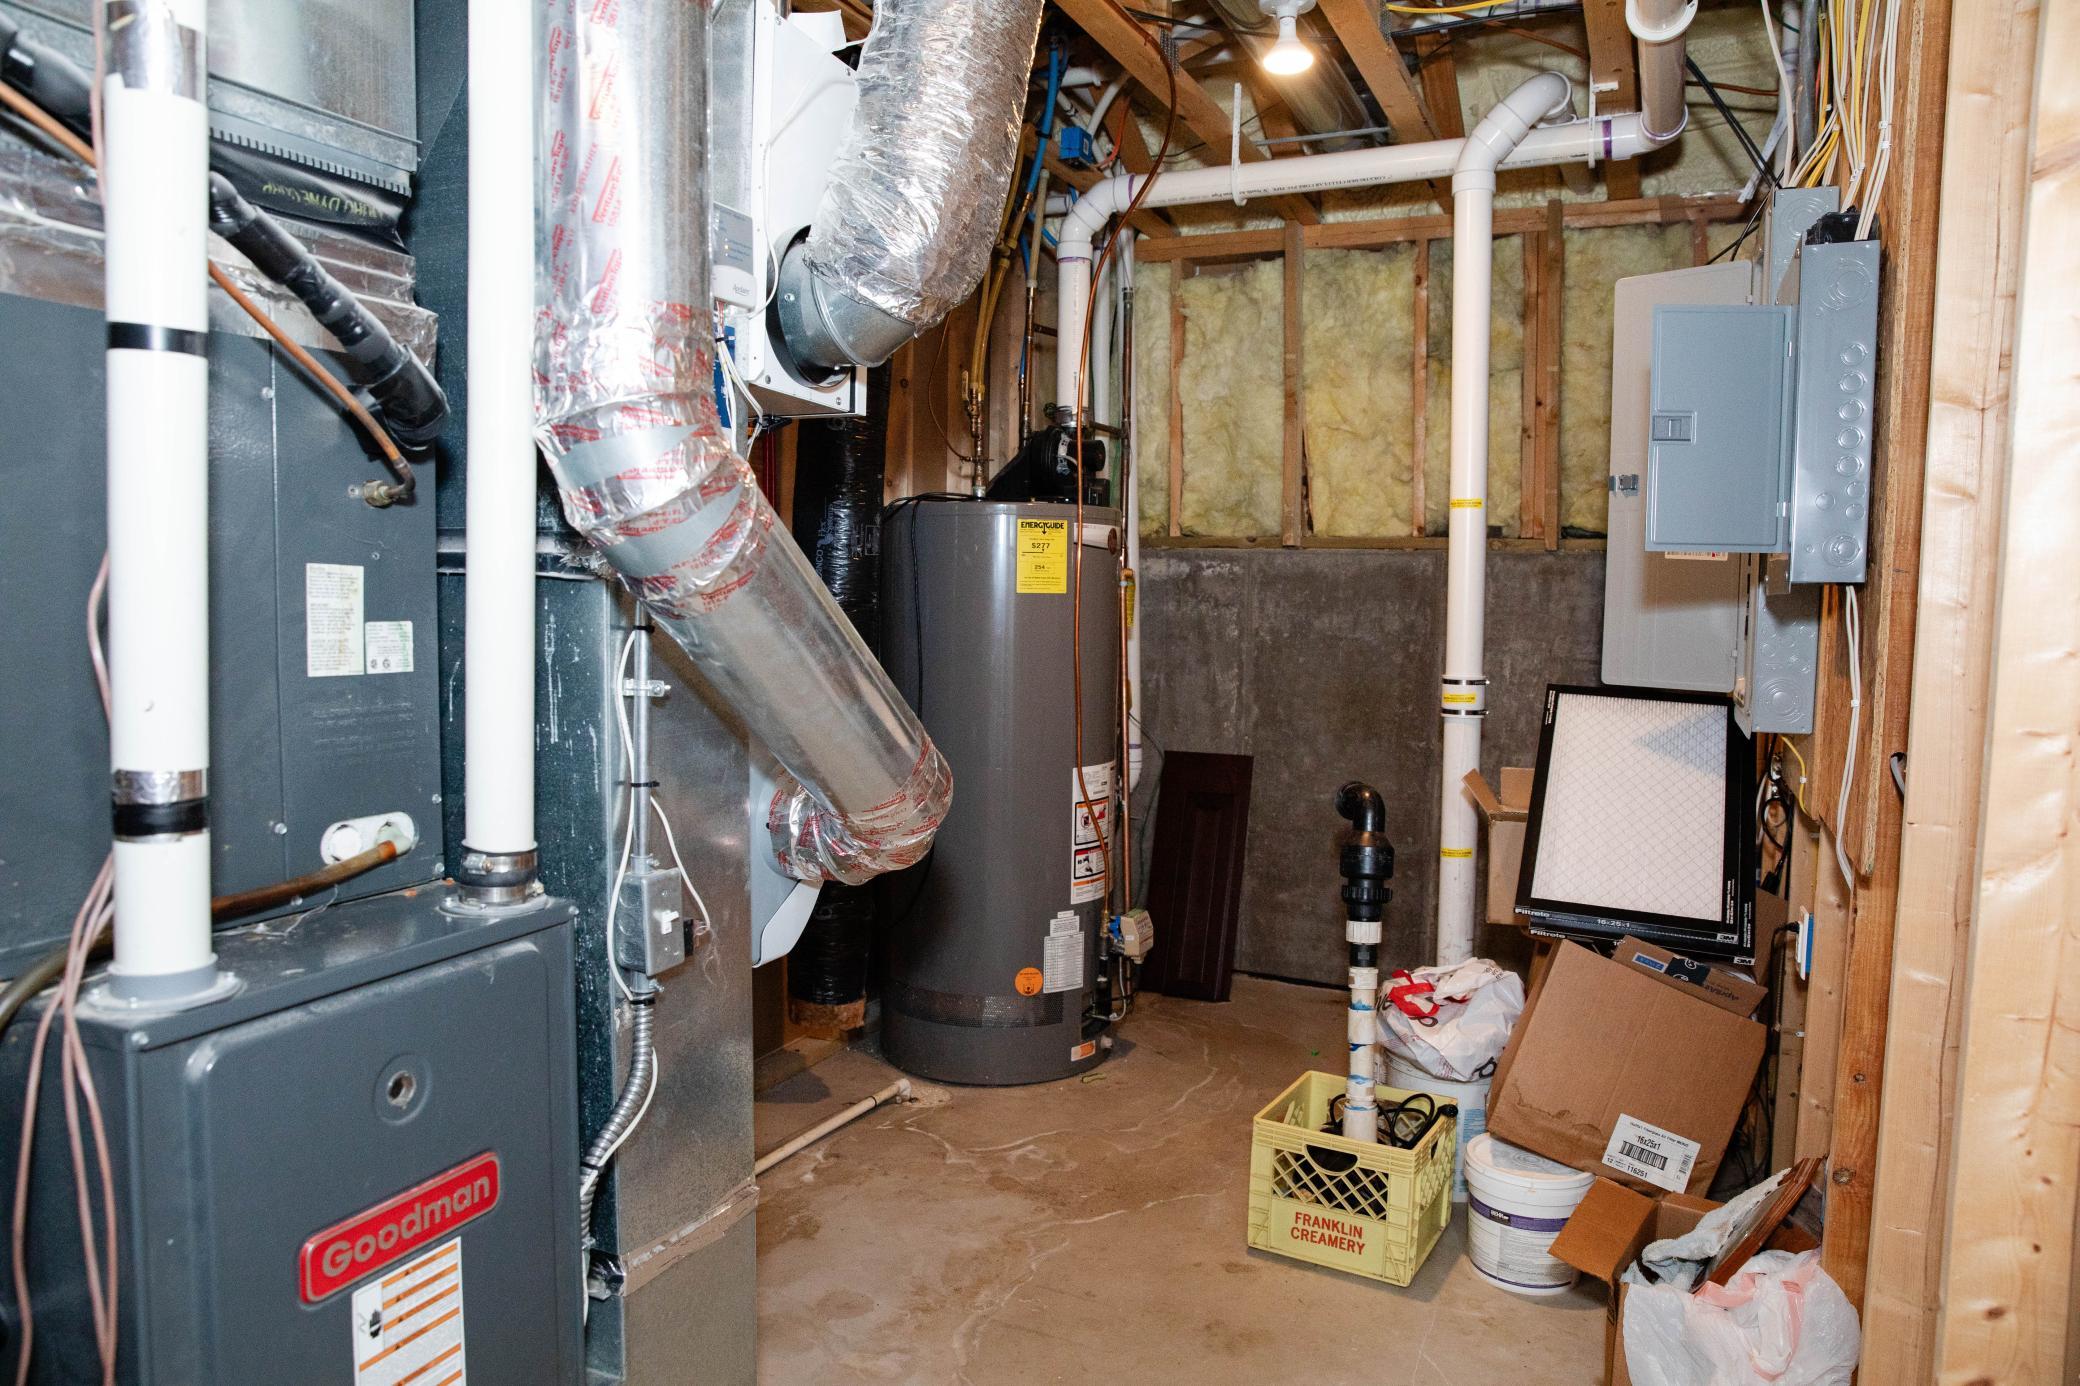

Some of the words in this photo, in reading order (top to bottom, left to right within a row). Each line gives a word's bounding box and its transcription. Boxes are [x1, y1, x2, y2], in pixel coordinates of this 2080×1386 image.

[322, 1176, 490, 1277] Goodman
[1295, 1212, 1363, 1239] FRANKLIN
[1290, 1226, 1365, 1255] CREAMERY
